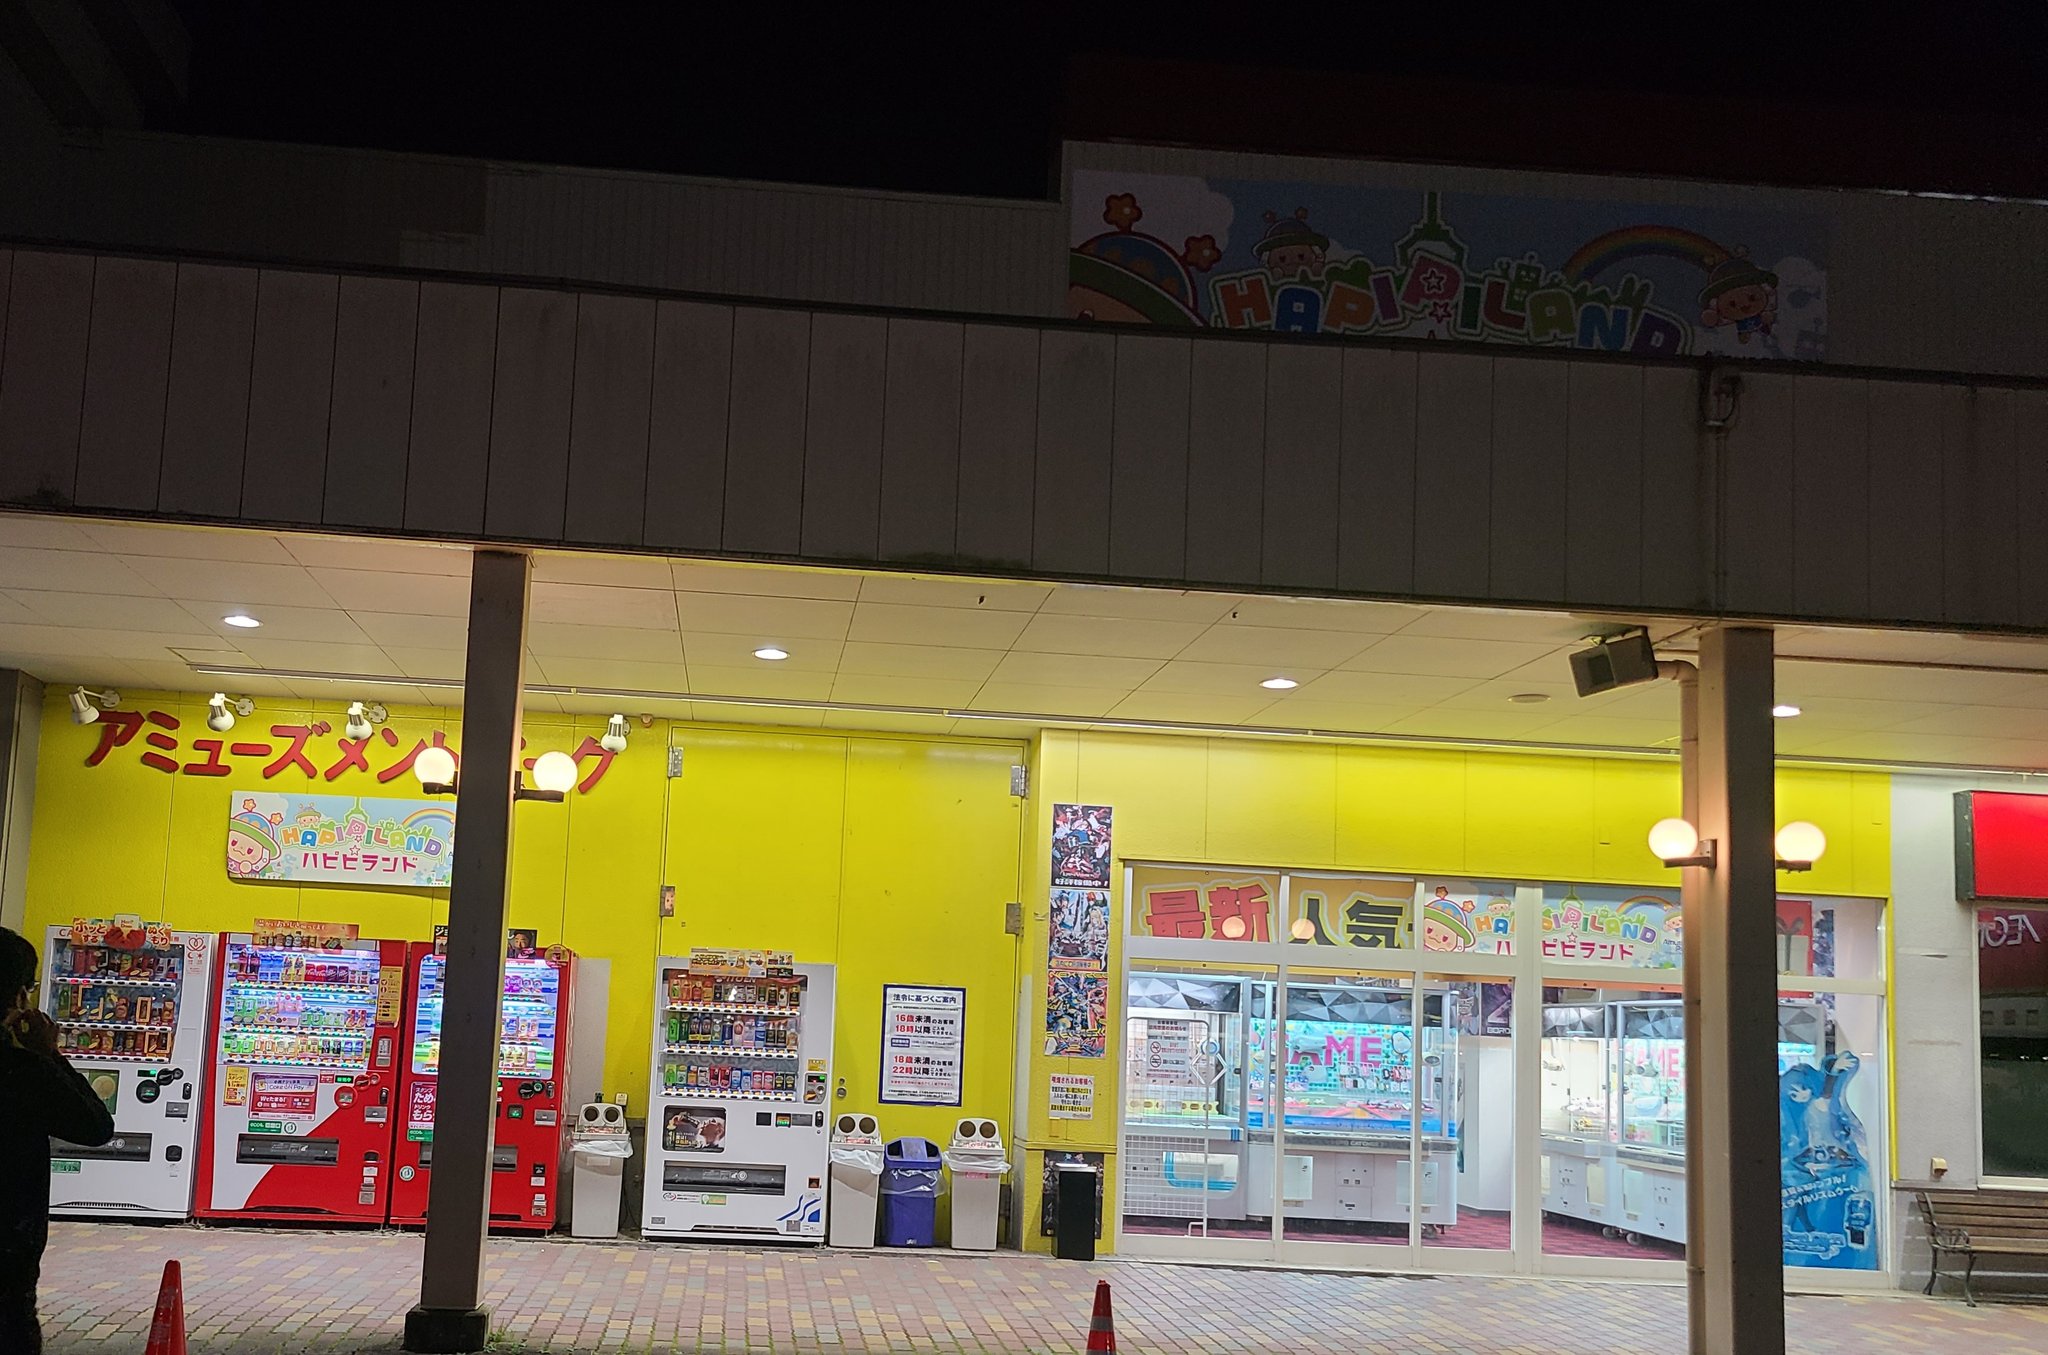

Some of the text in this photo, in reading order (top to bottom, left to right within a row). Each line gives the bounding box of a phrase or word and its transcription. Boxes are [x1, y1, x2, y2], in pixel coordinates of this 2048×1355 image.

[1219, 255, 1683, 353] HAPIPILAND
[281, 817, 443, 856] HAPIPILAND
[1146, 884, 1403, 949] 最新 人気
[75, 923, 106, 935] ホッと
[148, 927, 165, 936] ぬく
[83, 934, 99, 943] する
[151, 936, 169, 946] もり
[895, 1024, 931, 1034] 18時以降
[892, 1065, 930, 1076] 22時以降
